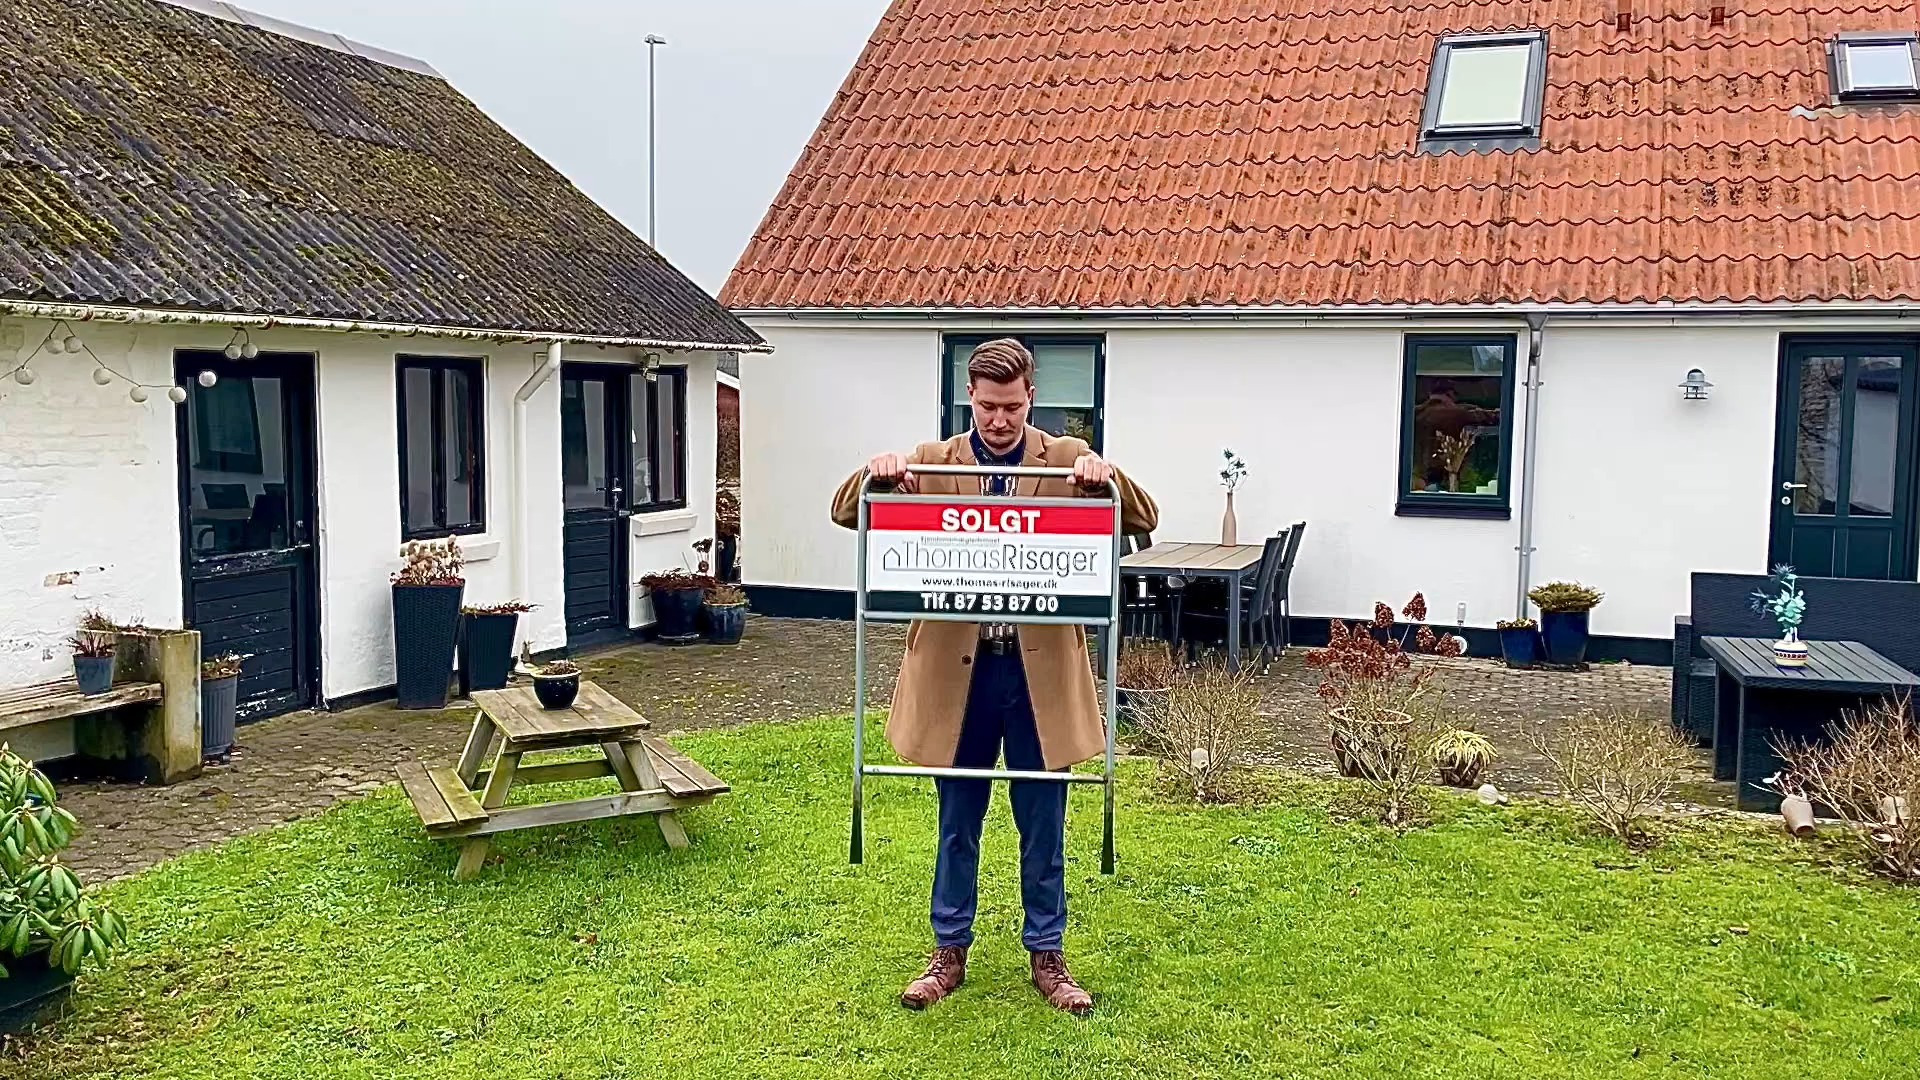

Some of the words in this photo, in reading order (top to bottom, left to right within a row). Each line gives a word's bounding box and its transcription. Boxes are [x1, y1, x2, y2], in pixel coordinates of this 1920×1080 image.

[941, 508, 1041, 533] SOLGT
[922, 576, 1057, 589] www.thomas-risager.dk
[920, 592, 950, 610] Tlf.
[954, 593, 977, 611] 87
[981, 594, 1004, 611] 53
[1008, 595, 1031, 612] 87
[1035, 595, 1059, 613] 00
